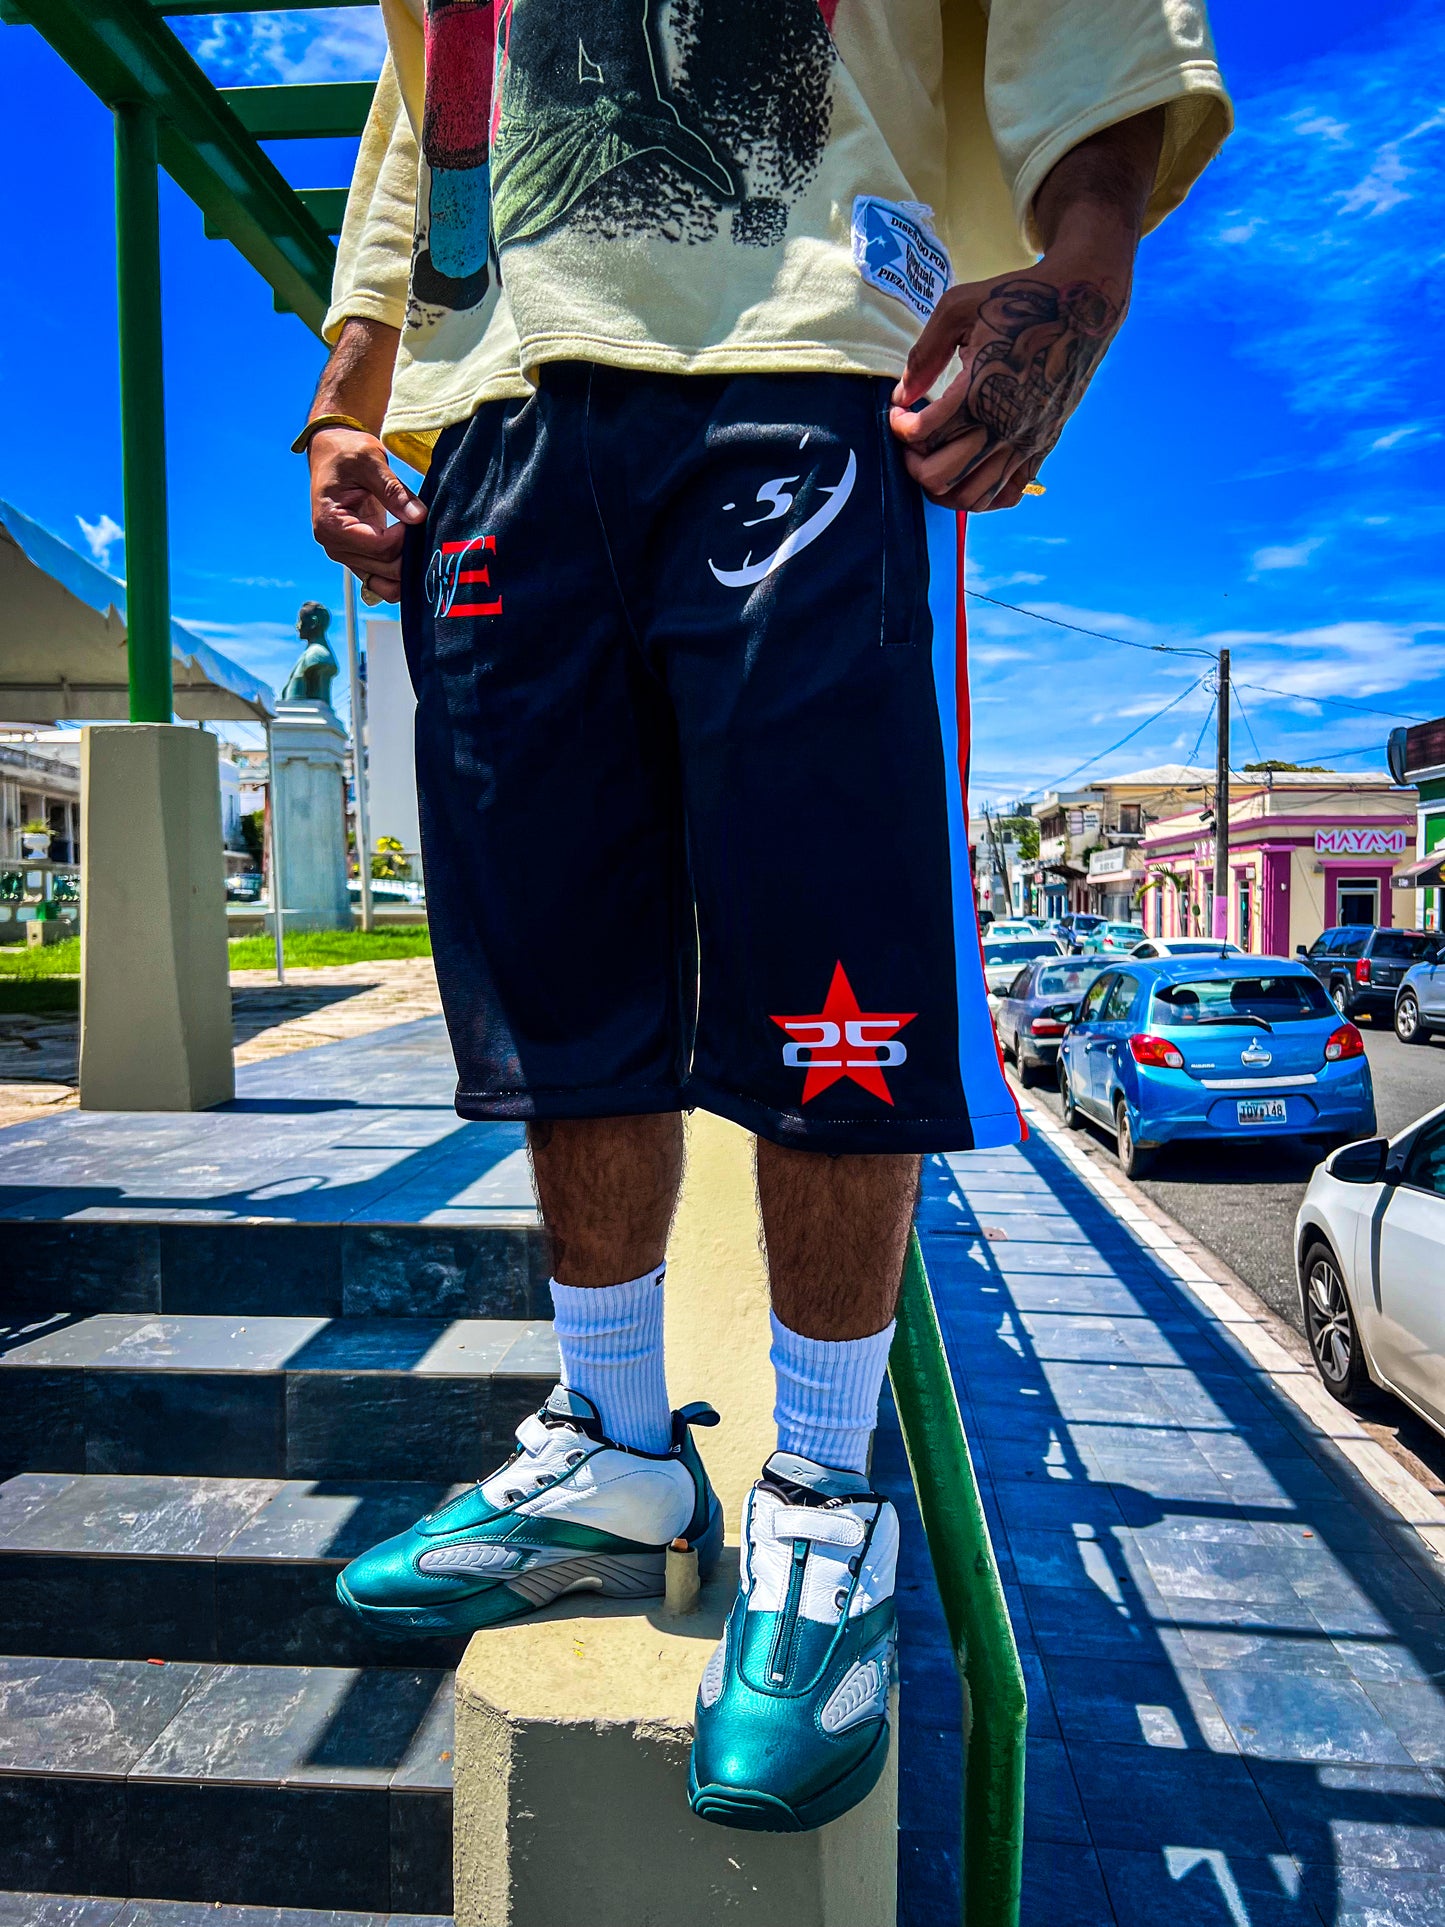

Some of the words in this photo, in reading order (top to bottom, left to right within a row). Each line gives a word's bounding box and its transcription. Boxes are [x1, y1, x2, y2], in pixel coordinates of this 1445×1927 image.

[928, 251, 947, 273] POR
[1315, 829, 1406, 853] MAYAMI
[782, 1020, 908, 1067] 25
